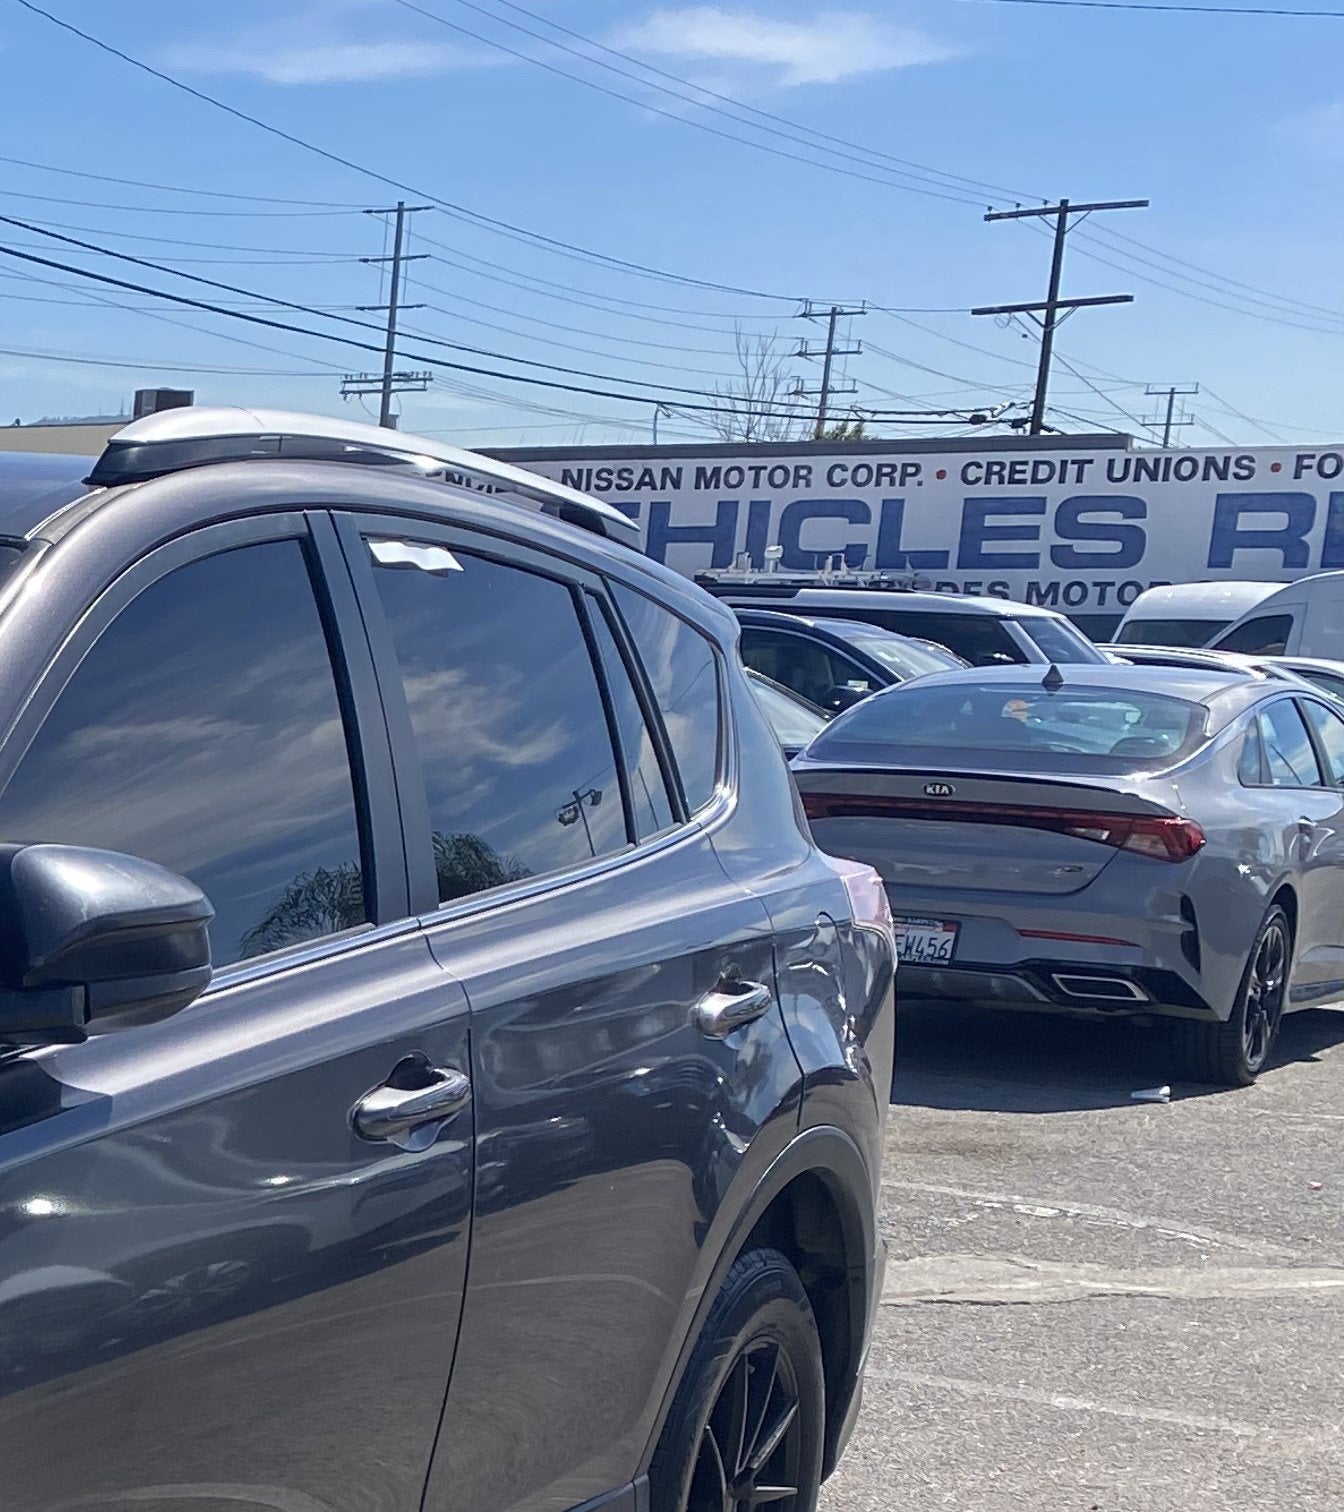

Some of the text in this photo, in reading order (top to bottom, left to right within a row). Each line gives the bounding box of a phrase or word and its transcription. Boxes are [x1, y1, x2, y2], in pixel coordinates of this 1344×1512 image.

[562, 466, 683, 492] NISSAN
[694, 464, 812, 490] MOTOR
[826, 462, 924, 488] CORP.
[960, 458, 1094, 485] CREDIT
[1106, 454, 1257, 483] UNIONS
[609, 490, 1344, 569] HICLES R
[1025, 580, 1174, 607] MOTO
[926, 784, 950, 795] KIA
